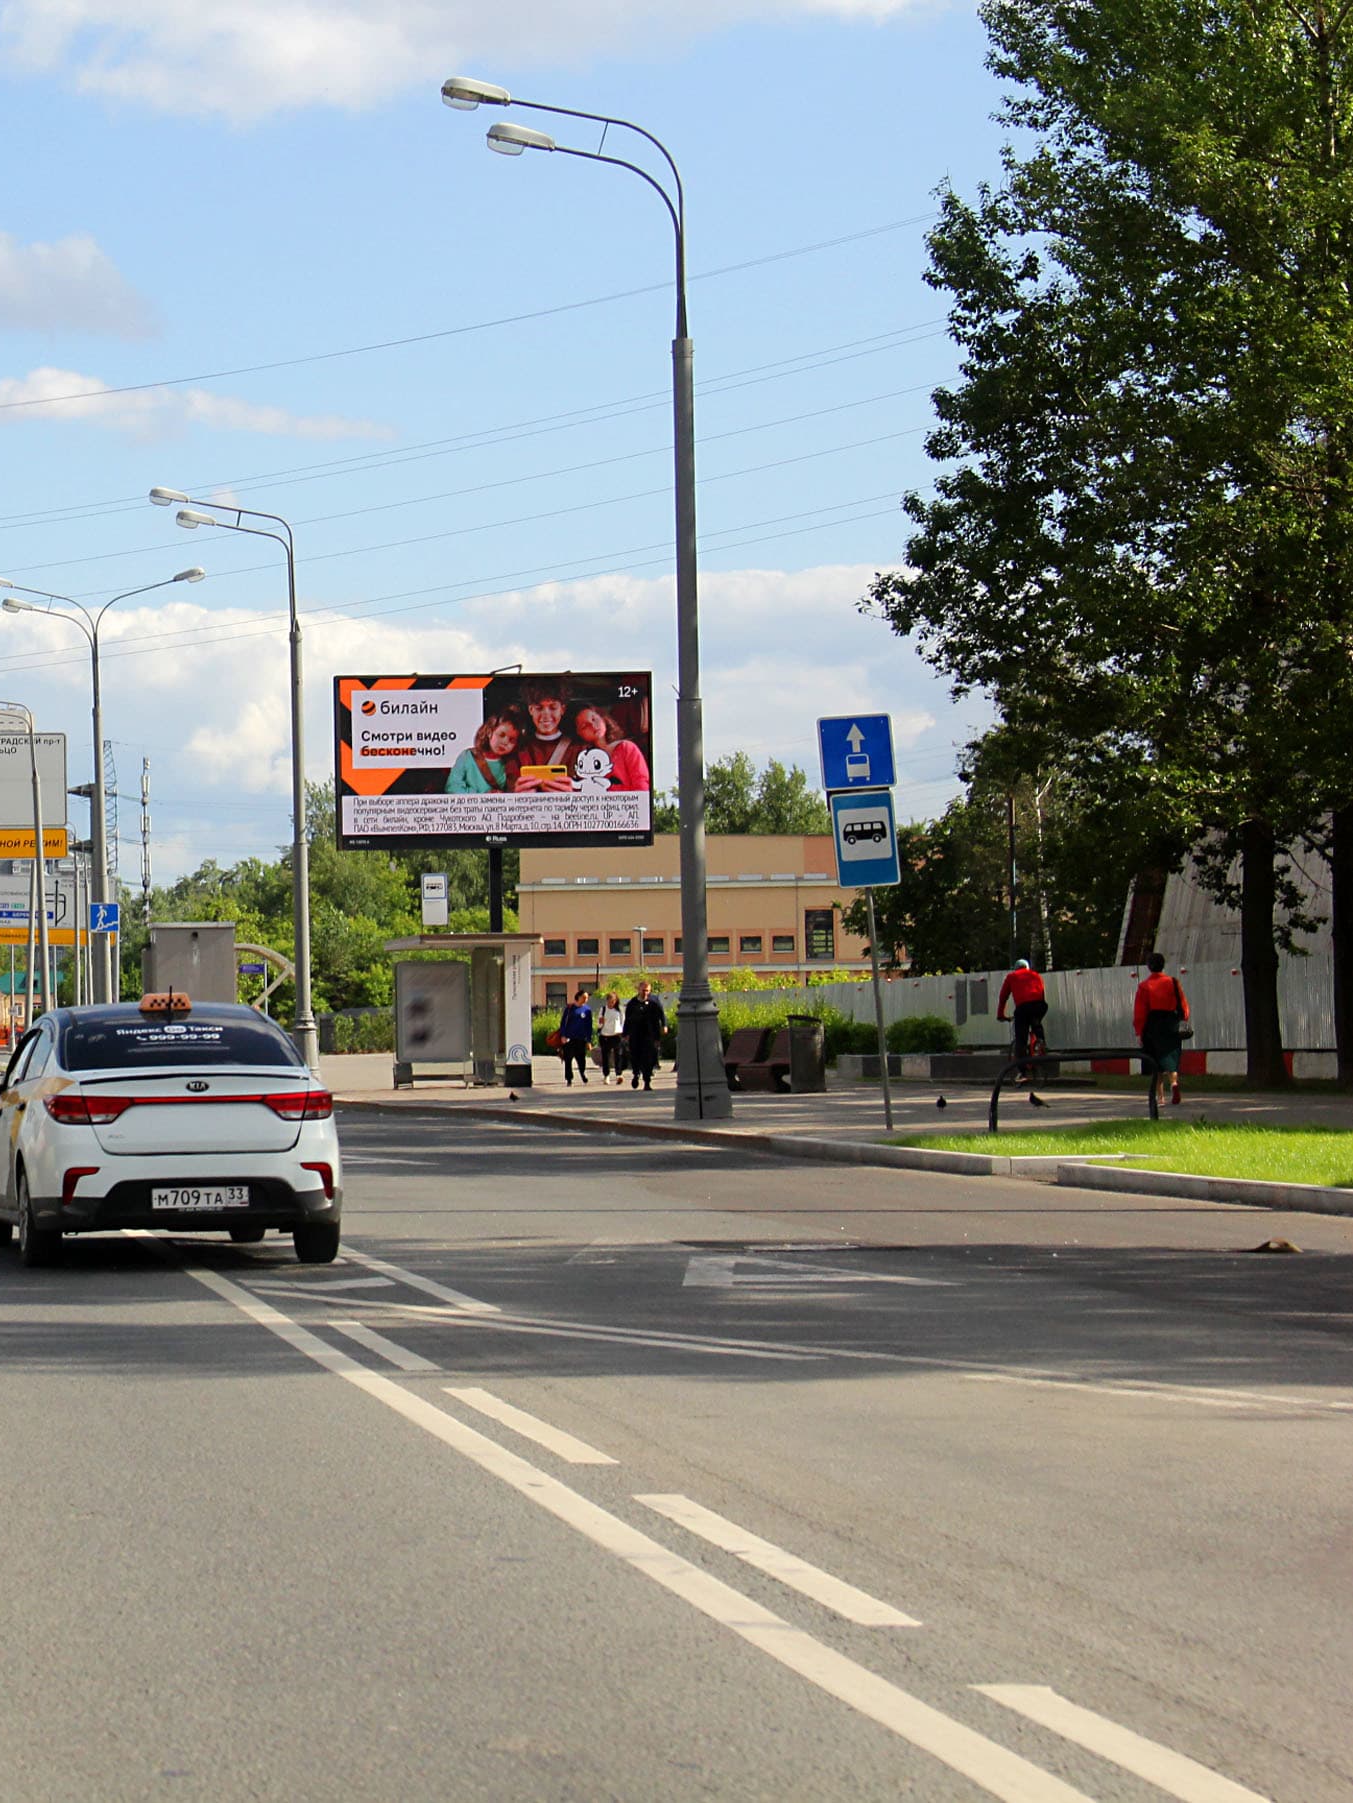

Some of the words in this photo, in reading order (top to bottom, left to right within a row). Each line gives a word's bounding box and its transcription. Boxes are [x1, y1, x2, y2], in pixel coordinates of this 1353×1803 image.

[618, 686, 638, 697] 12+
[380, 701, 438, 714] билайн
[361, 730, 413, 744] Смотри
[416, 731, 457, 742] видео
[360, 744, 445, 757] бесконечно!
[23, 838, 63, 849] РЕИМ!
[116, 1027, 162, 1036] Яндекс
[189, 1082, 206, 1090] KIA
